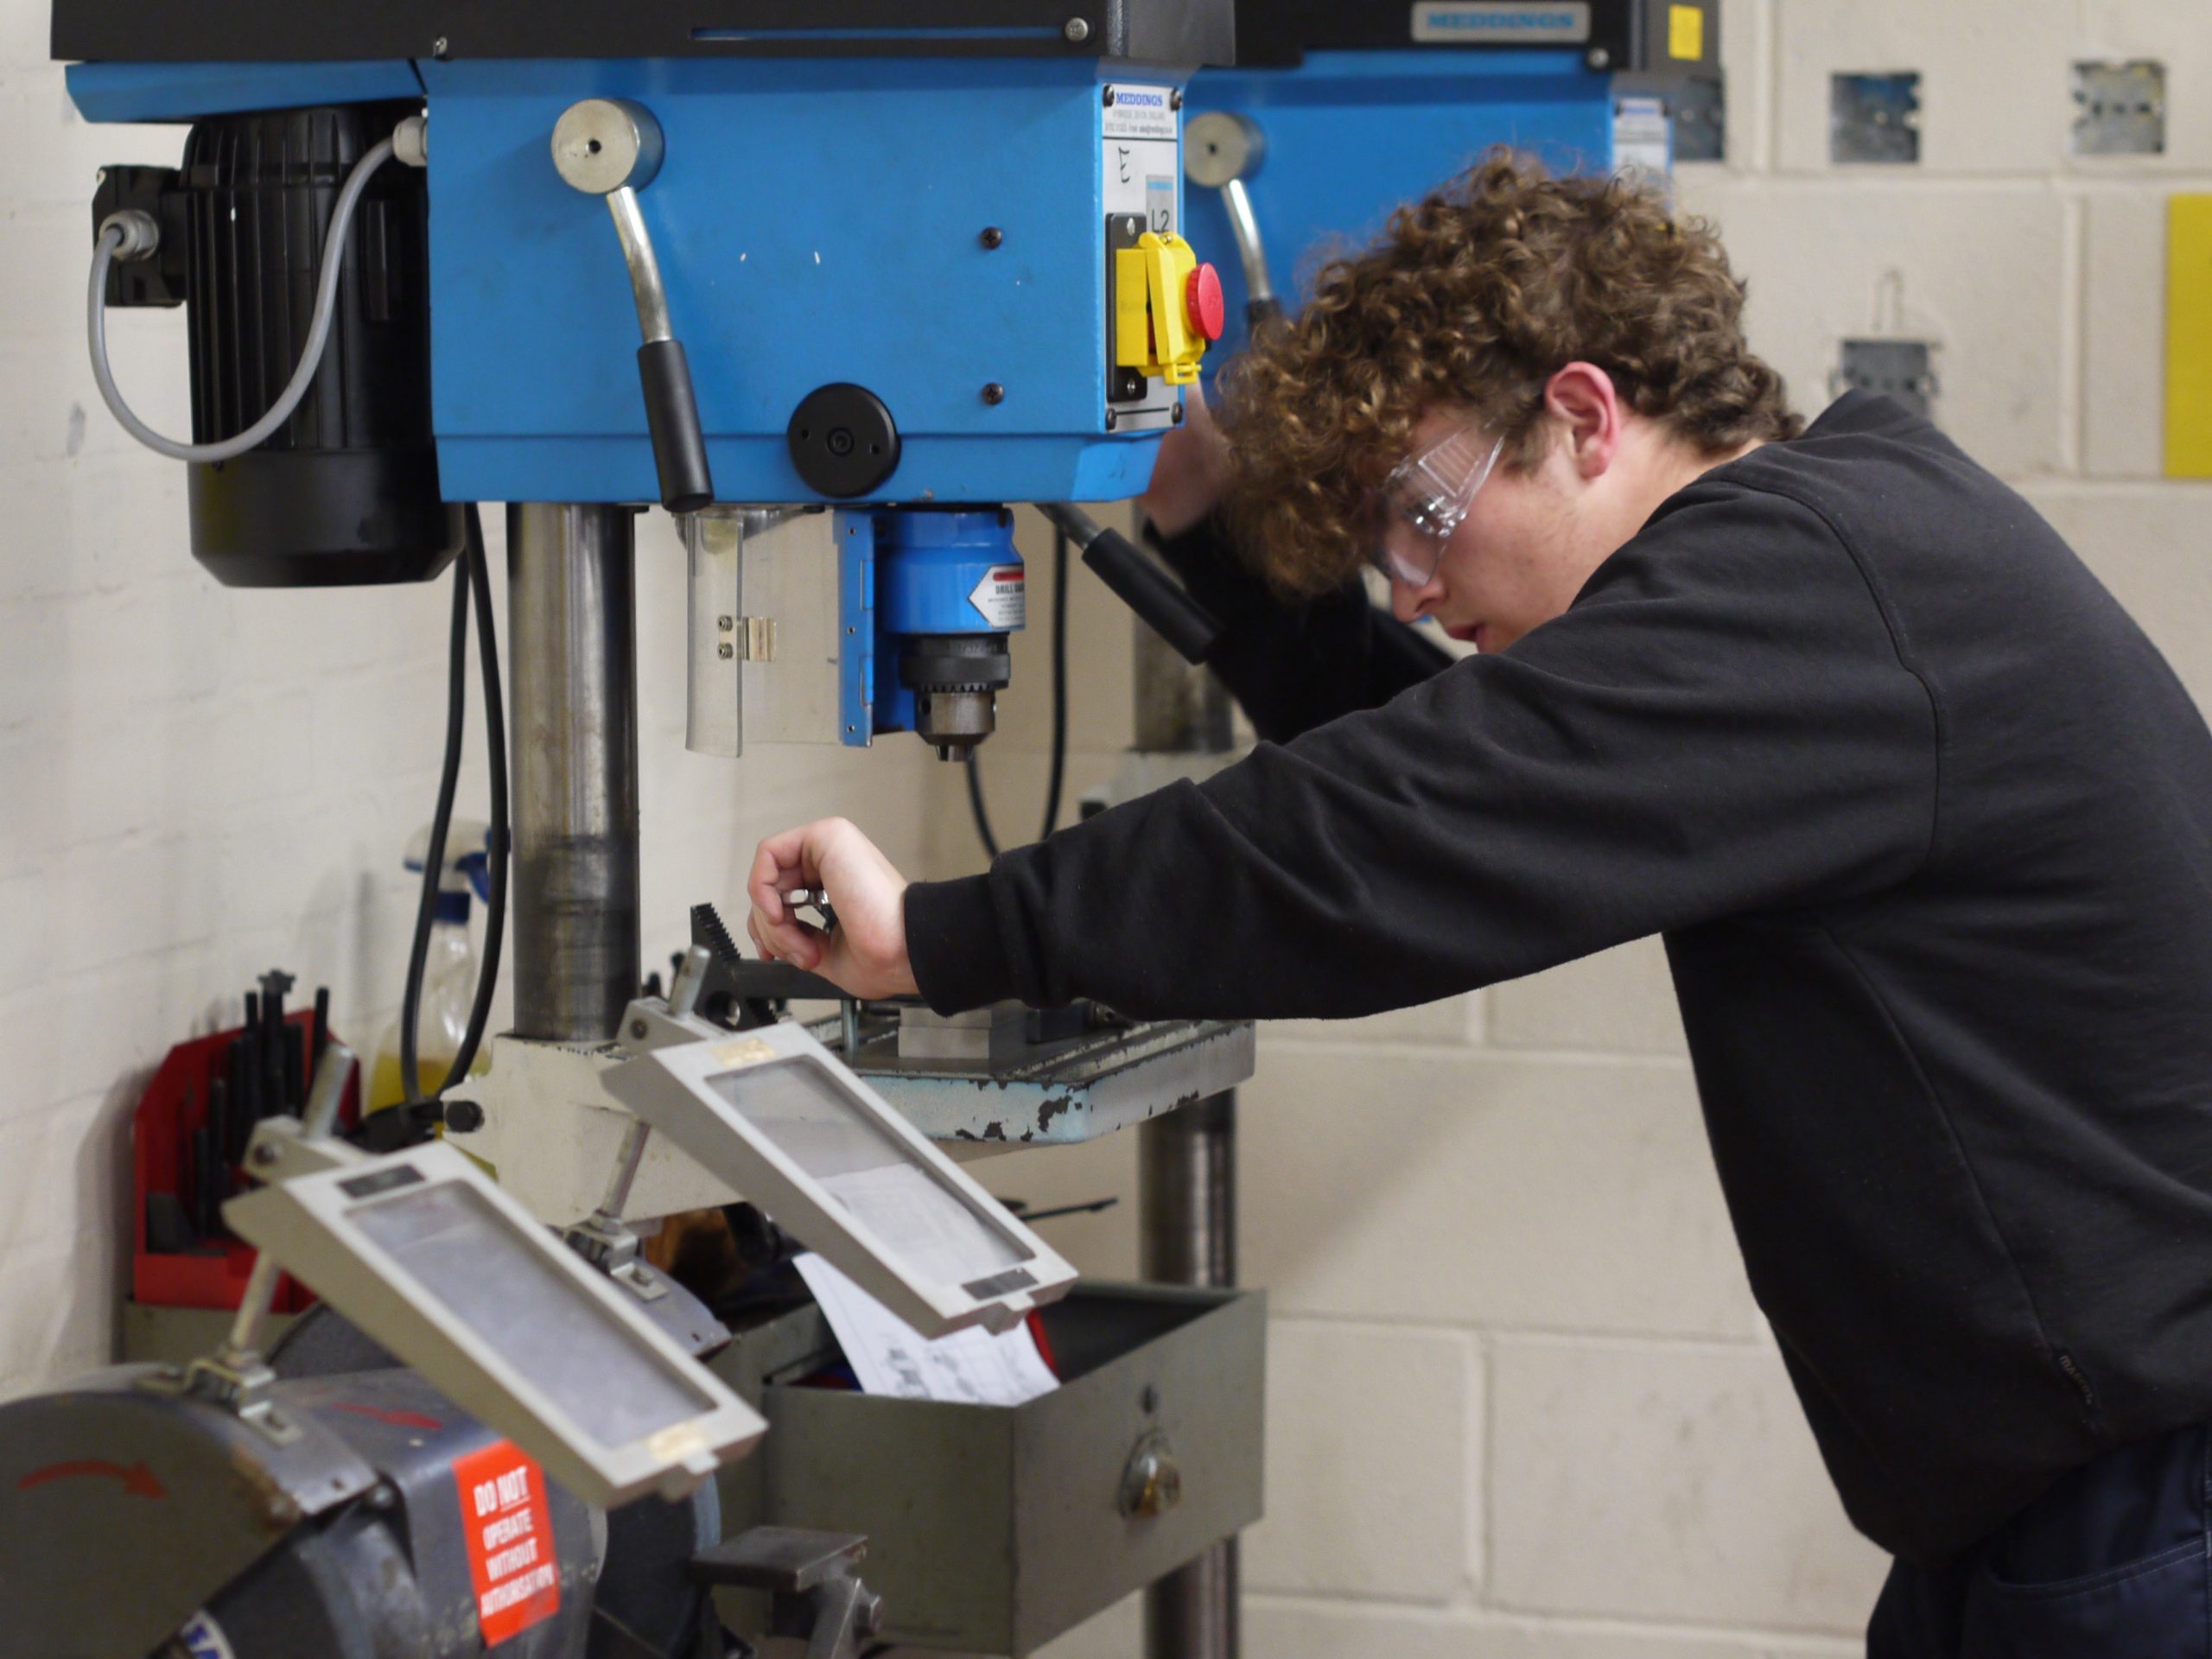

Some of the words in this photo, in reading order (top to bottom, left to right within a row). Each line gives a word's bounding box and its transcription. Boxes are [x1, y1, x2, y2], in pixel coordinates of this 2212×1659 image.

[1428, 13, 1573, 28] MEDDINGS
[1116, 92, 1163, 105] MEDDINGS
[1152, 209, 1170, 232] L2
[474, 1480, 497, 1517] DO
[497, 1465, 528, 1507] NOT
[482, 1508, 534, 1551] OPERATE
[486, 1537, 538, 1582] WITHOUT
